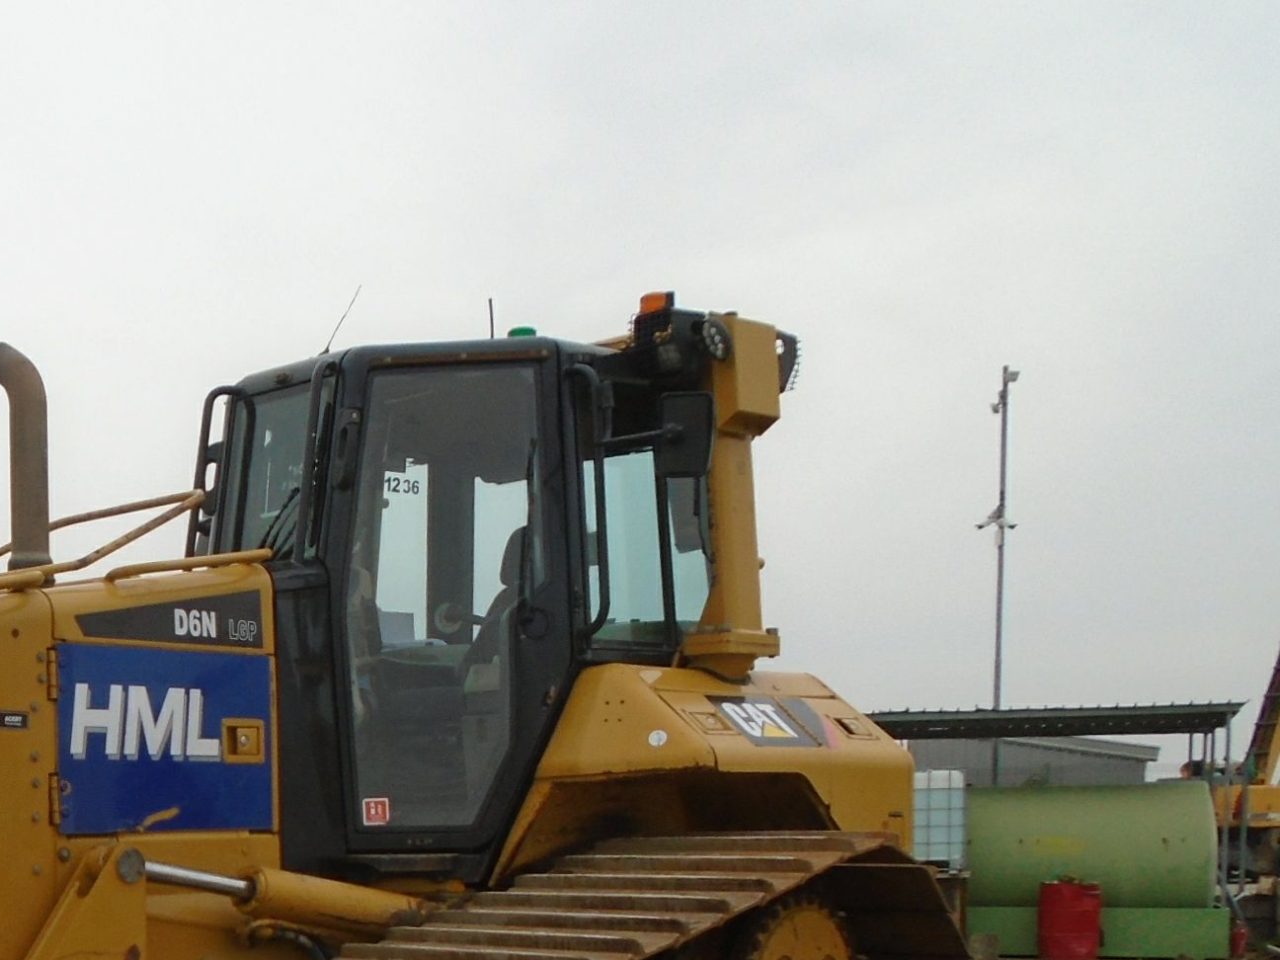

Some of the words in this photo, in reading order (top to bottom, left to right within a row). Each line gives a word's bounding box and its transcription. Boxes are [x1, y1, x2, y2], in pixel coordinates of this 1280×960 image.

[384, 476, 419, 495] 1236
[173, 608, 217, 639] D6N
[228, 618, 257, 642] LGP
[70, 682, 221, 762] HML
[720, 701, 799, 738] CAT
